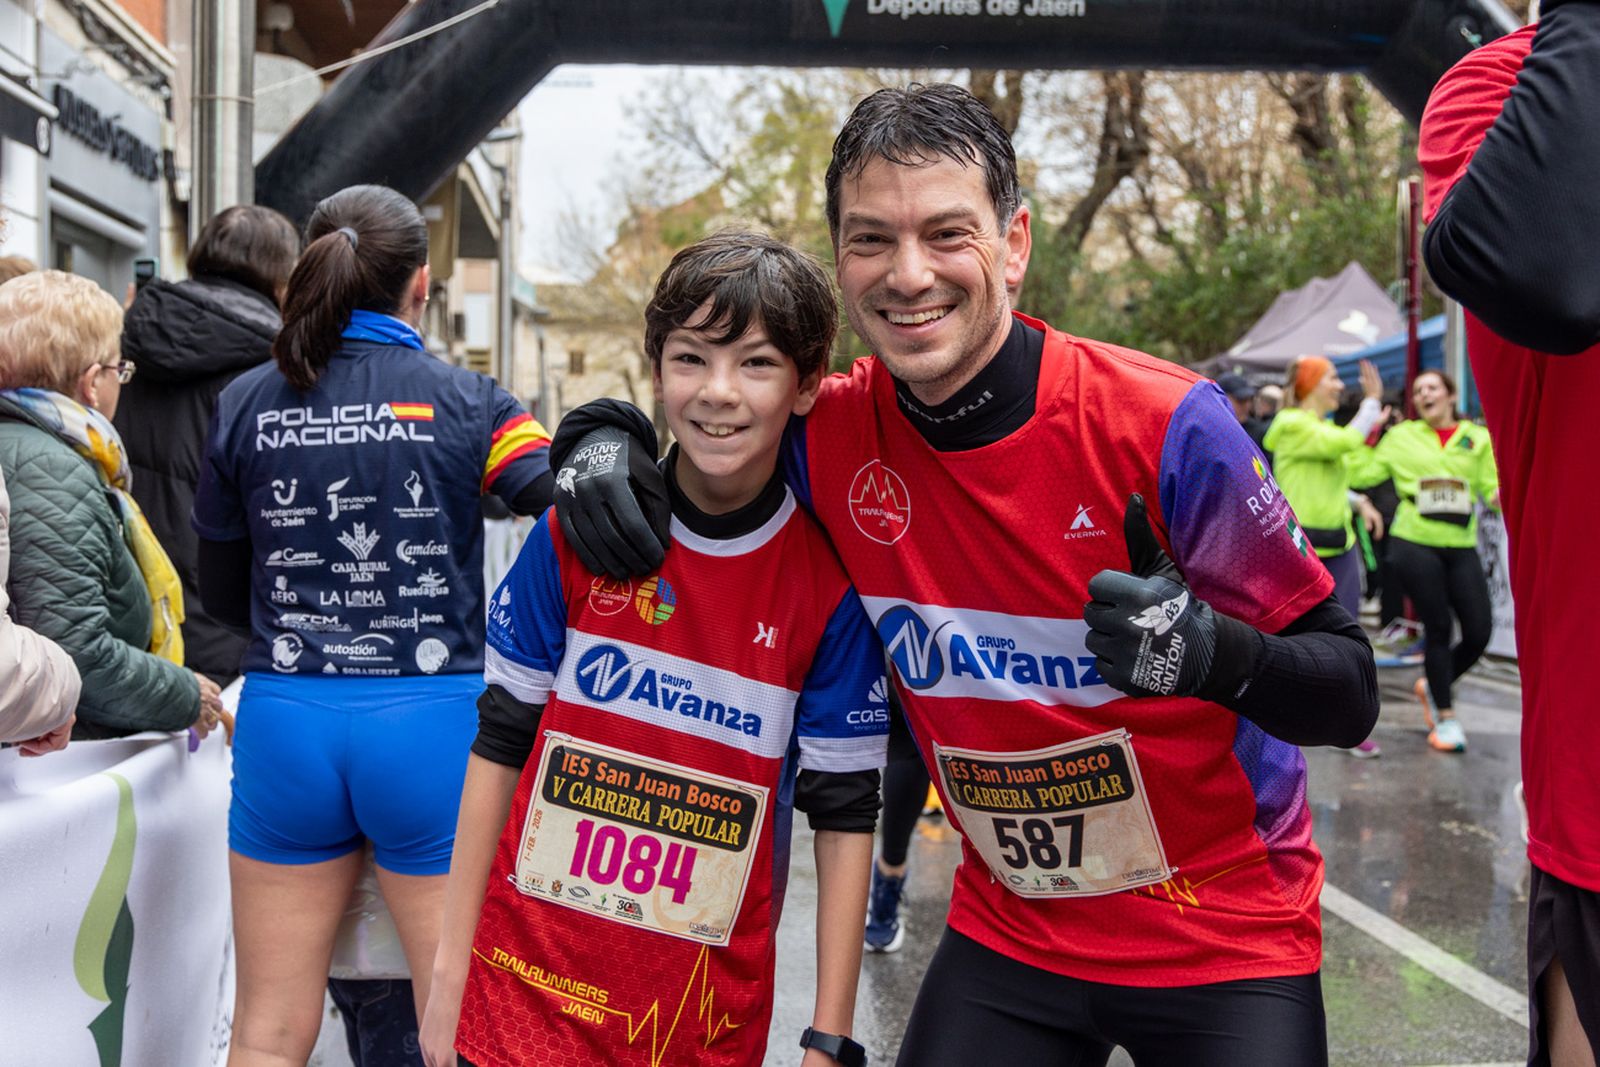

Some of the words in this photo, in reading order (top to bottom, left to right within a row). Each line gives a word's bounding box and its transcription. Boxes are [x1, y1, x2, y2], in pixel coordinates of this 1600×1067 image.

[867, 0, 981, 20] Deportes
[986, 0, 1020, 15] de
[257, 403, 397, 431] POLICIA
[256, 422, 434, 451] NACIONAL
[261, 507, 318, 519] Ayuntamiento
[271, 519, 282, 527] de
[1064, 530, 1107, 539] EVERNYA
[283, 547, 318, 561] Campos
[320, 590, 342, 605] LA
[1164, 601, 1180, 622] 43
[323, 643, 377, 656] autostión
[976, 635, 1016, 651] GRUPO
[949, 633, 1103, 688] Avanz
[1149, 653, 1166, 693] SAN
[1160, 632, 1183, 696] ANTÓN
[661, 673, 692, 691] GRUPO
[628, 669, 762, 738] Avanza
[846, 709, 891, 724] cas
[946, 760, 970, 780] IES
[972, 763, 1001, 784] San
[1004, 766, 1048, 784] Juan
[1051, 753, 1111, 779] Bosco
[561, 753, 591, 777] IES
[594, 762, 631, 788] San
[634, 772, 681, 800] Juan
[686, 784, 742, 815] Bosco
[963, 784, 1035, 809] CARRERA
[1036, 774, 1126, 808] POPULAR
[553, 775, 564, 798] V
[568, 779, 651, 823] CARRERA
[656, 804, 742, 846] POPULAR
[991, 813, 1084, 870] 587
[568, 818, 698, 905] 1084
[492, 946, 609, 1004] TRAILRUNNERS
[561, 1001, 605, 1025] JAEN
